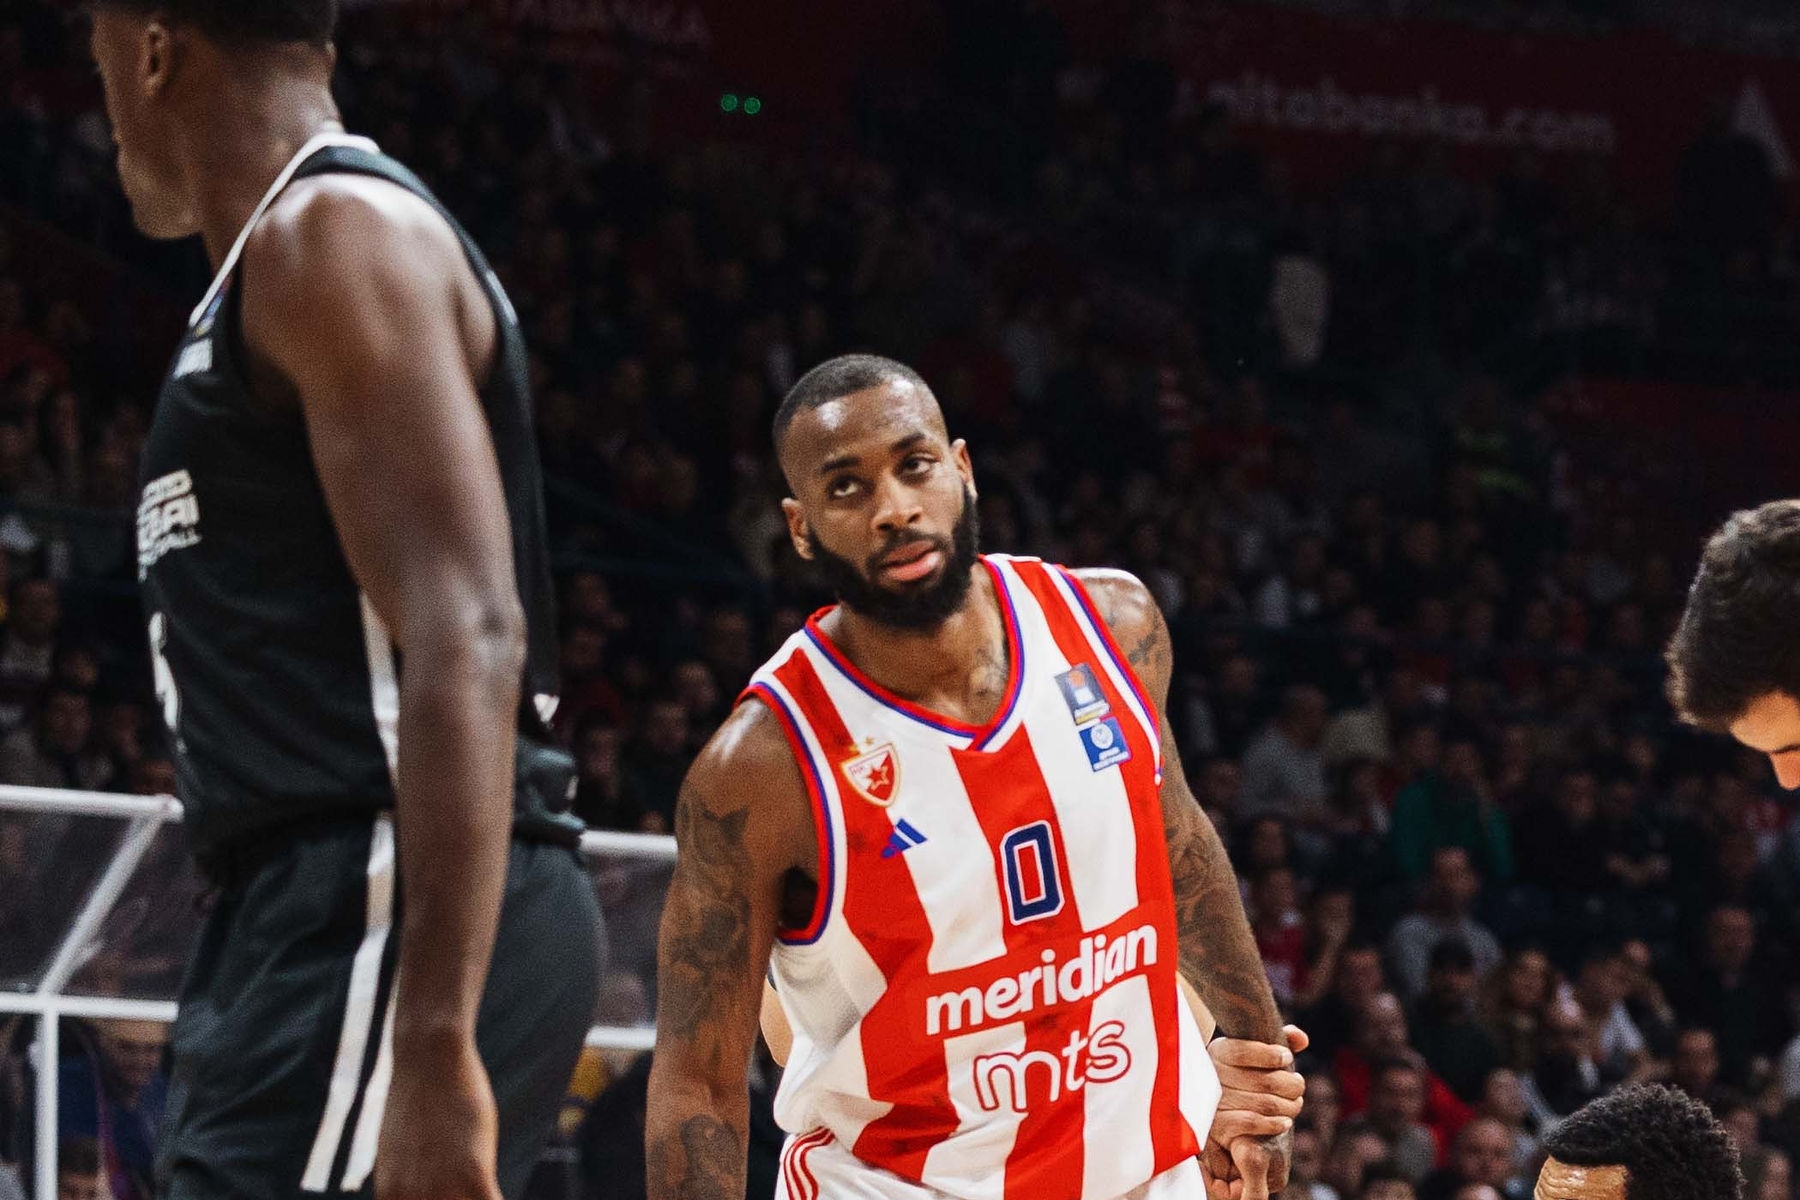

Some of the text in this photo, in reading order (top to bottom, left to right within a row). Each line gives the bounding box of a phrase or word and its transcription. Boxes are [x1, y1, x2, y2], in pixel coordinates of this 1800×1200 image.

[1000, 819, 1065, 926] 0
[926, 925, 1158, 1036] meridian
[973, 1020, 1131, 1113] mts
